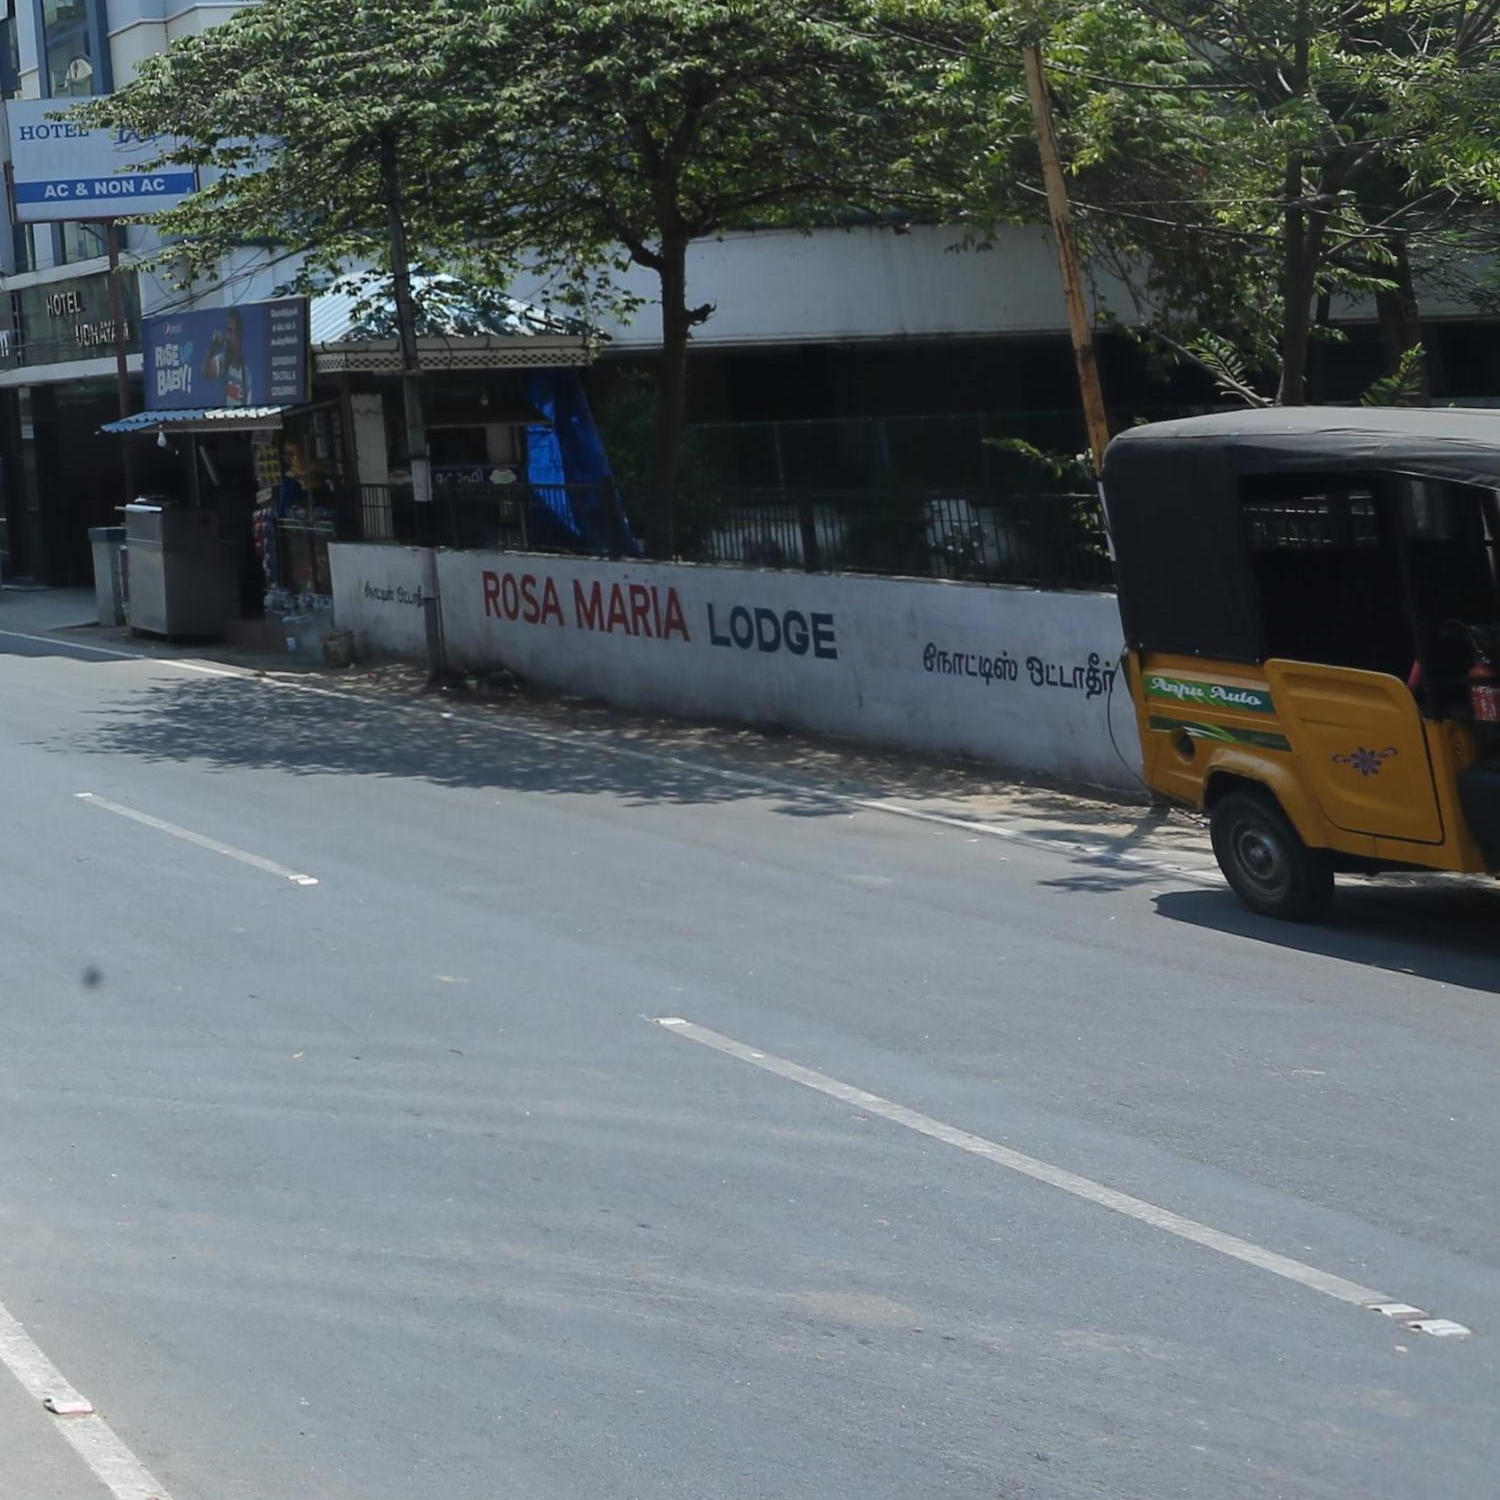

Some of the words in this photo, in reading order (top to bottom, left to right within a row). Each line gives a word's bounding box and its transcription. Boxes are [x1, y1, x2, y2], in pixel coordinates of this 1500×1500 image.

[19, 123, 90, 141] HOTEL
[44, 183, 69, 198] AC
[75, 181, 89, 195] &
[95, 179, 136, 195] NON
[140, 177, 166, 192] AC
[48, 291, 80, 317] HOTEL
[75, 318, 129, 348] UDHAY
[155, 342, 179, 367] RISE
[157, 363, 192, 396] BABY!
[482, 570, 565, 627] ROSA
[572, 579, 691, 642] MARIA
[707, 602, 838, 660] LODGE
[1151, 676, 1205, 701] Anpu
[1210, 685, 1262, 706] Auto
